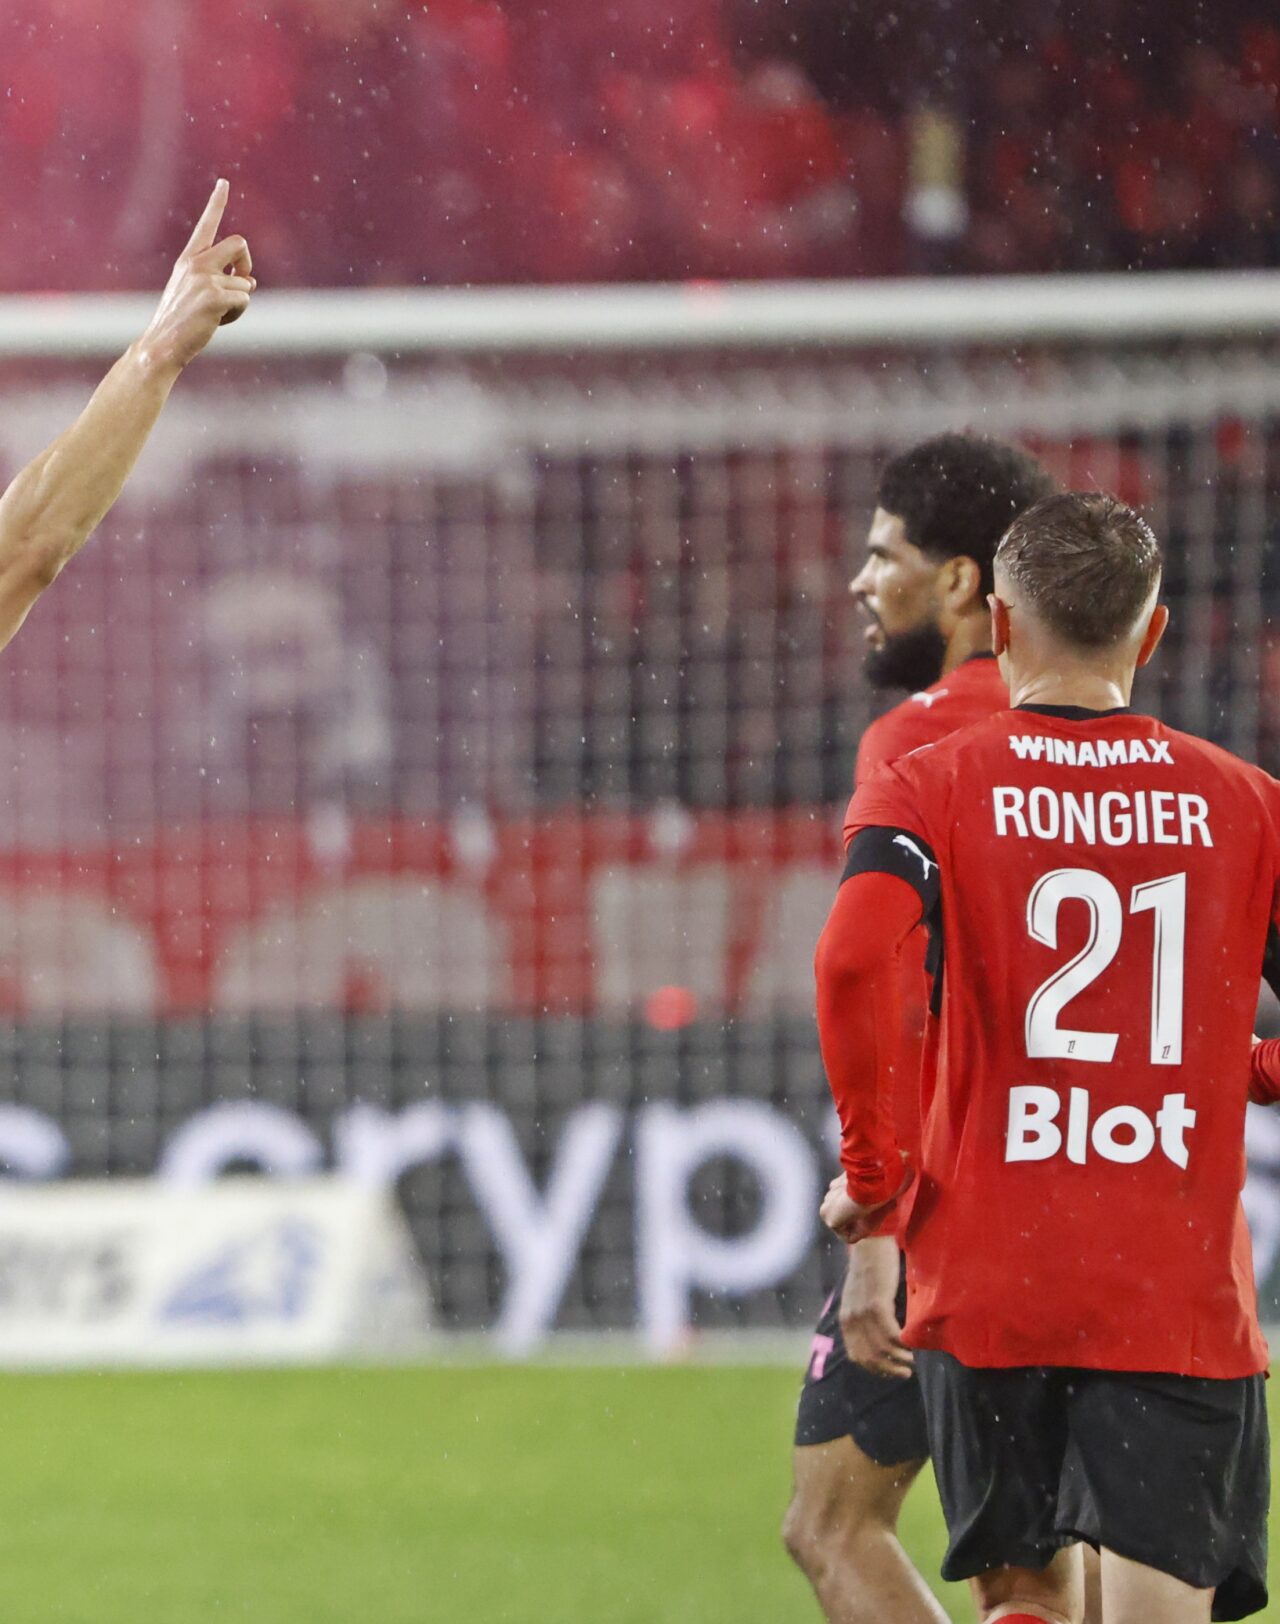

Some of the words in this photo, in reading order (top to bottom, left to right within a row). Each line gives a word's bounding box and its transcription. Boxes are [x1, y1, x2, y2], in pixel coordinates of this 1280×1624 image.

[1009, 735, 1174, 768] WINAMAX
[993, 786, 1214, 847] RONGIER
[1026, 868, 1187, 1066] 21
[1005, 1085, 1196, 1170] Blot
